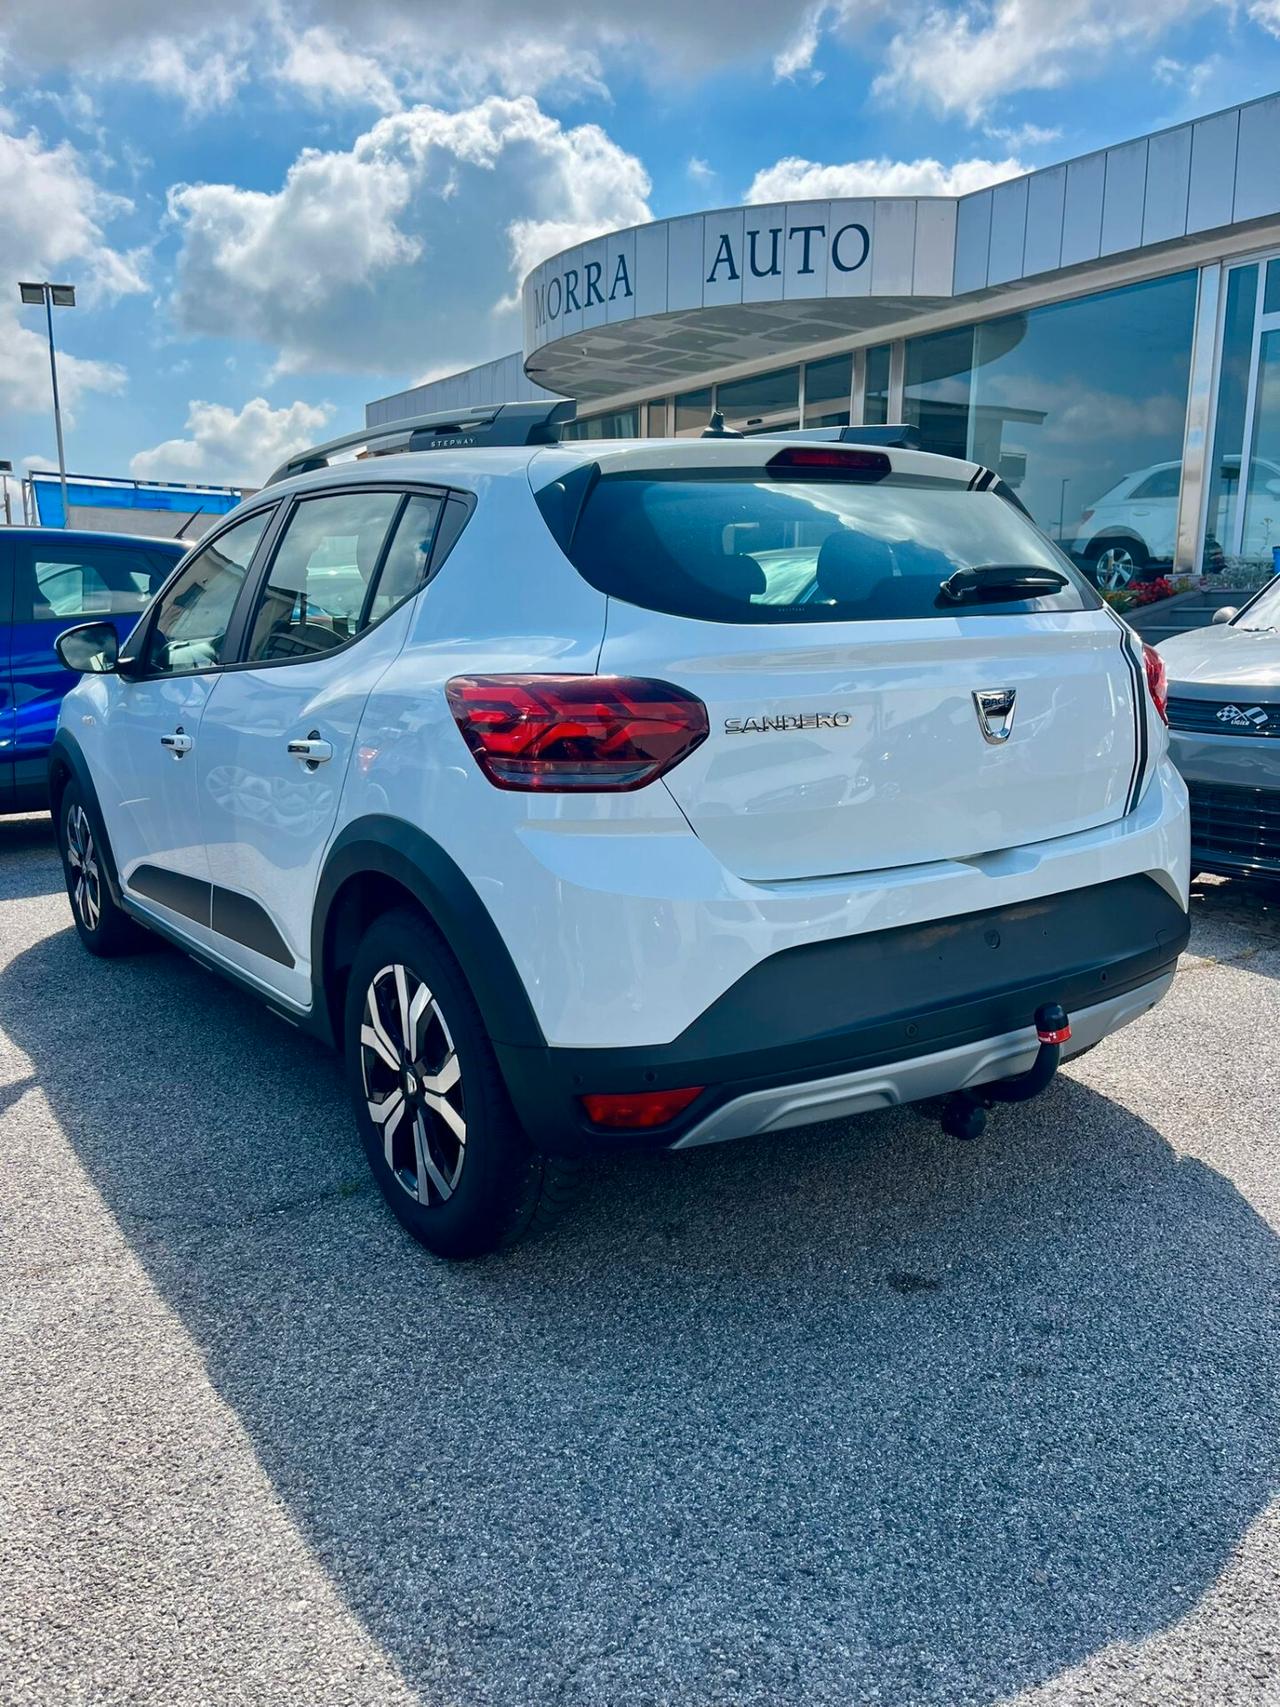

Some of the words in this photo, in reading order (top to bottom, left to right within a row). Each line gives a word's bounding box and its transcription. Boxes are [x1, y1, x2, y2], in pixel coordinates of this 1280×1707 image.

[535, 254, 633, 328] MORRA
[706, 223, 870, 283] AUTO
[430, 438, 474, 448] STEPWAY
[724, 711, 852, 734] SANDERO
